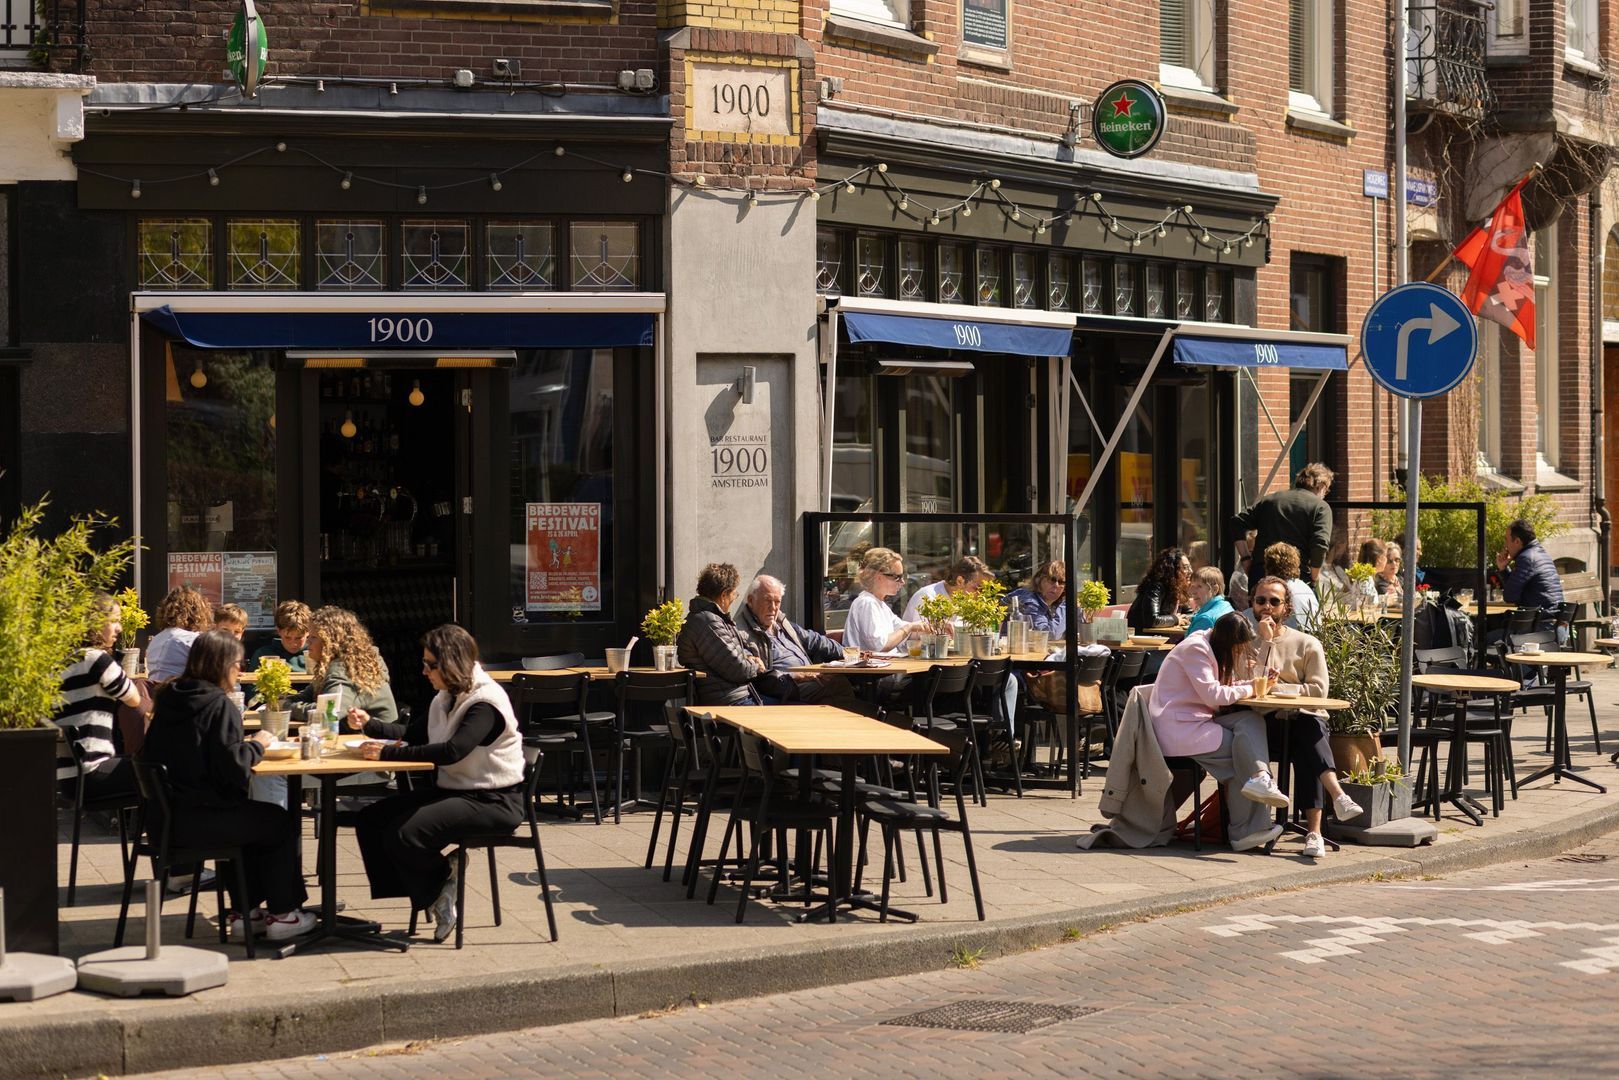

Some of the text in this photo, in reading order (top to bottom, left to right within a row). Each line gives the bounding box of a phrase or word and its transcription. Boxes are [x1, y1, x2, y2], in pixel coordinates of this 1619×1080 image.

[712, 84, 770, 117] 1900
[1100, 120, 1152, 133] Heineken
[368, 317, 433, 342] 1900
[953, 324, 981, 347] 1900
[1254, 344, 1279, 364] 1900
[711, 435, 723, 443] BAR
[711, 447, 767, 474] 1900
[711, 478, 768, 488] AMSTERDAM
[529, 505, 598, 517] BREDEWEG
[921, 501, 938, 514] 1900
[528, 517, 598, 531] FESTIVAL
[169, 554, 221, 563] BREDEWEG
[169, 562, 221, 573] FESTIVAL
